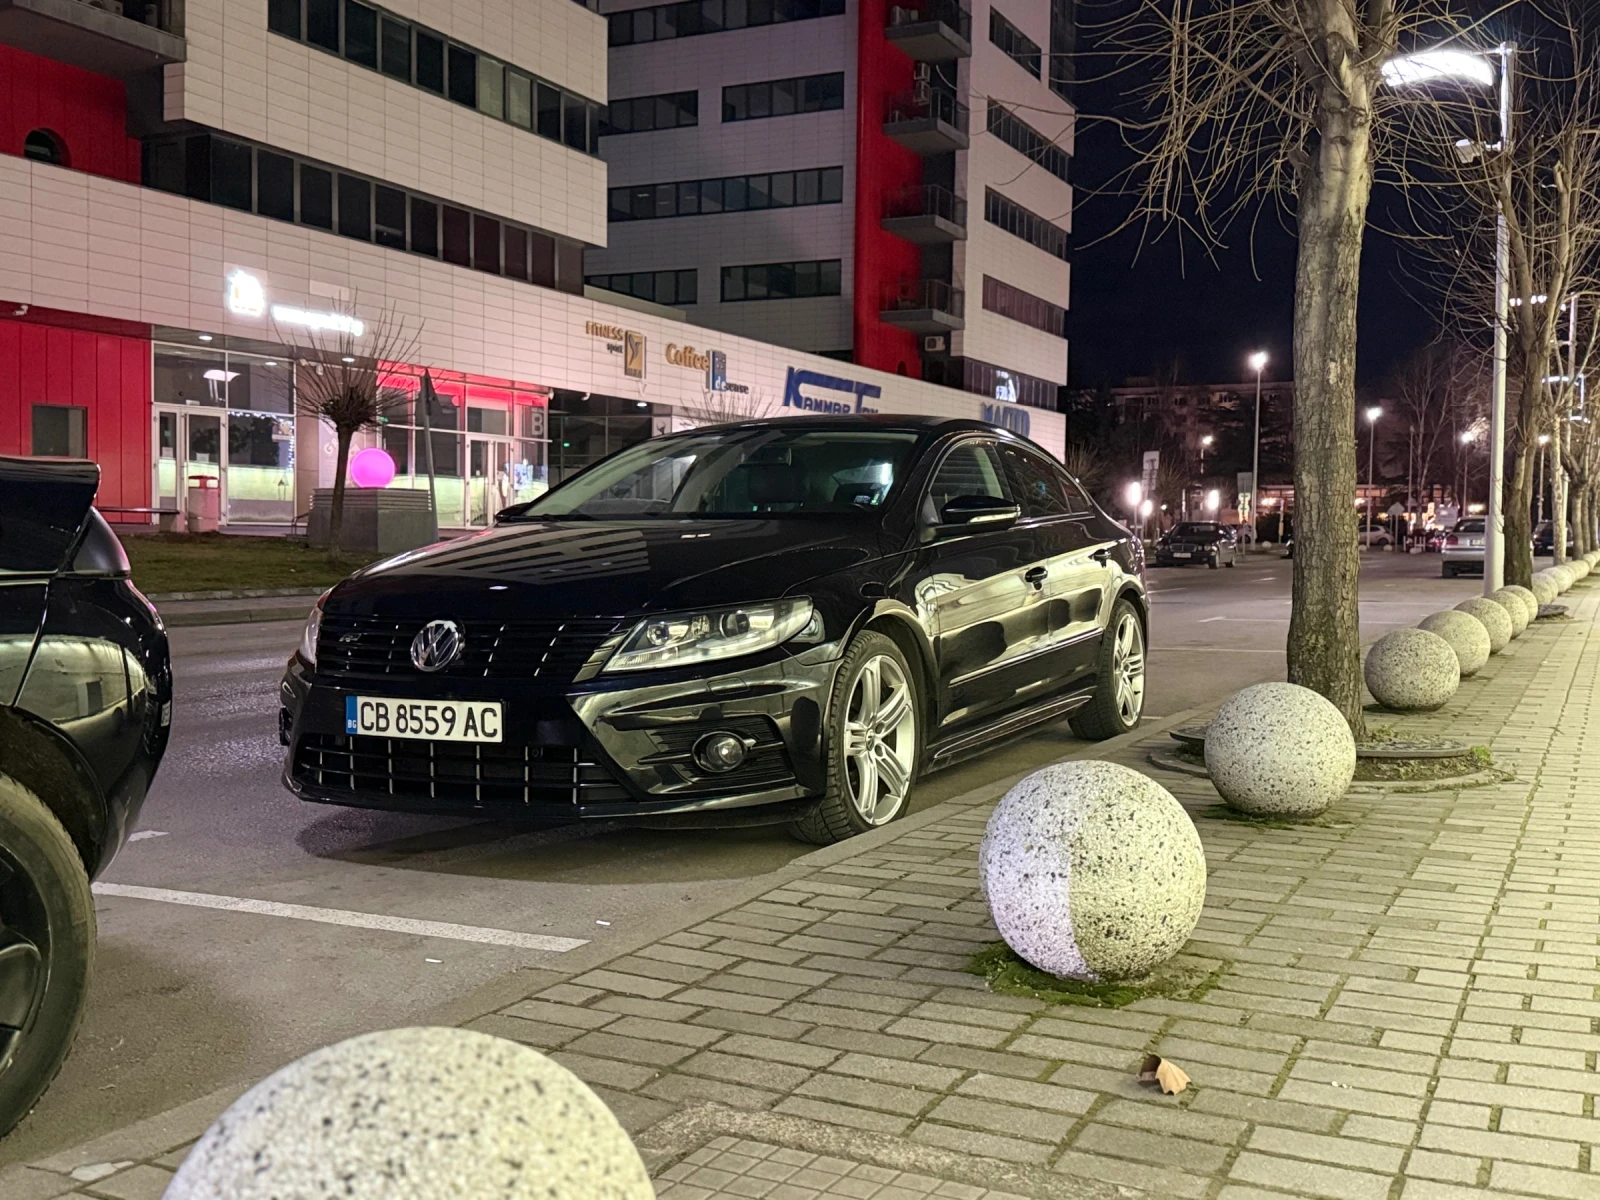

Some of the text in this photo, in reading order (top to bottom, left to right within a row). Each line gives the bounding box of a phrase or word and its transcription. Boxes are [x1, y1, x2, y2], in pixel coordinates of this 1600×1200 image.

[586, 321, 623, 341] FITNESS
[666, 343, 710, 371] Coffee
[347, 719, 357, 729] BG
[360, 701, 498, 738] CB 8559 AC
